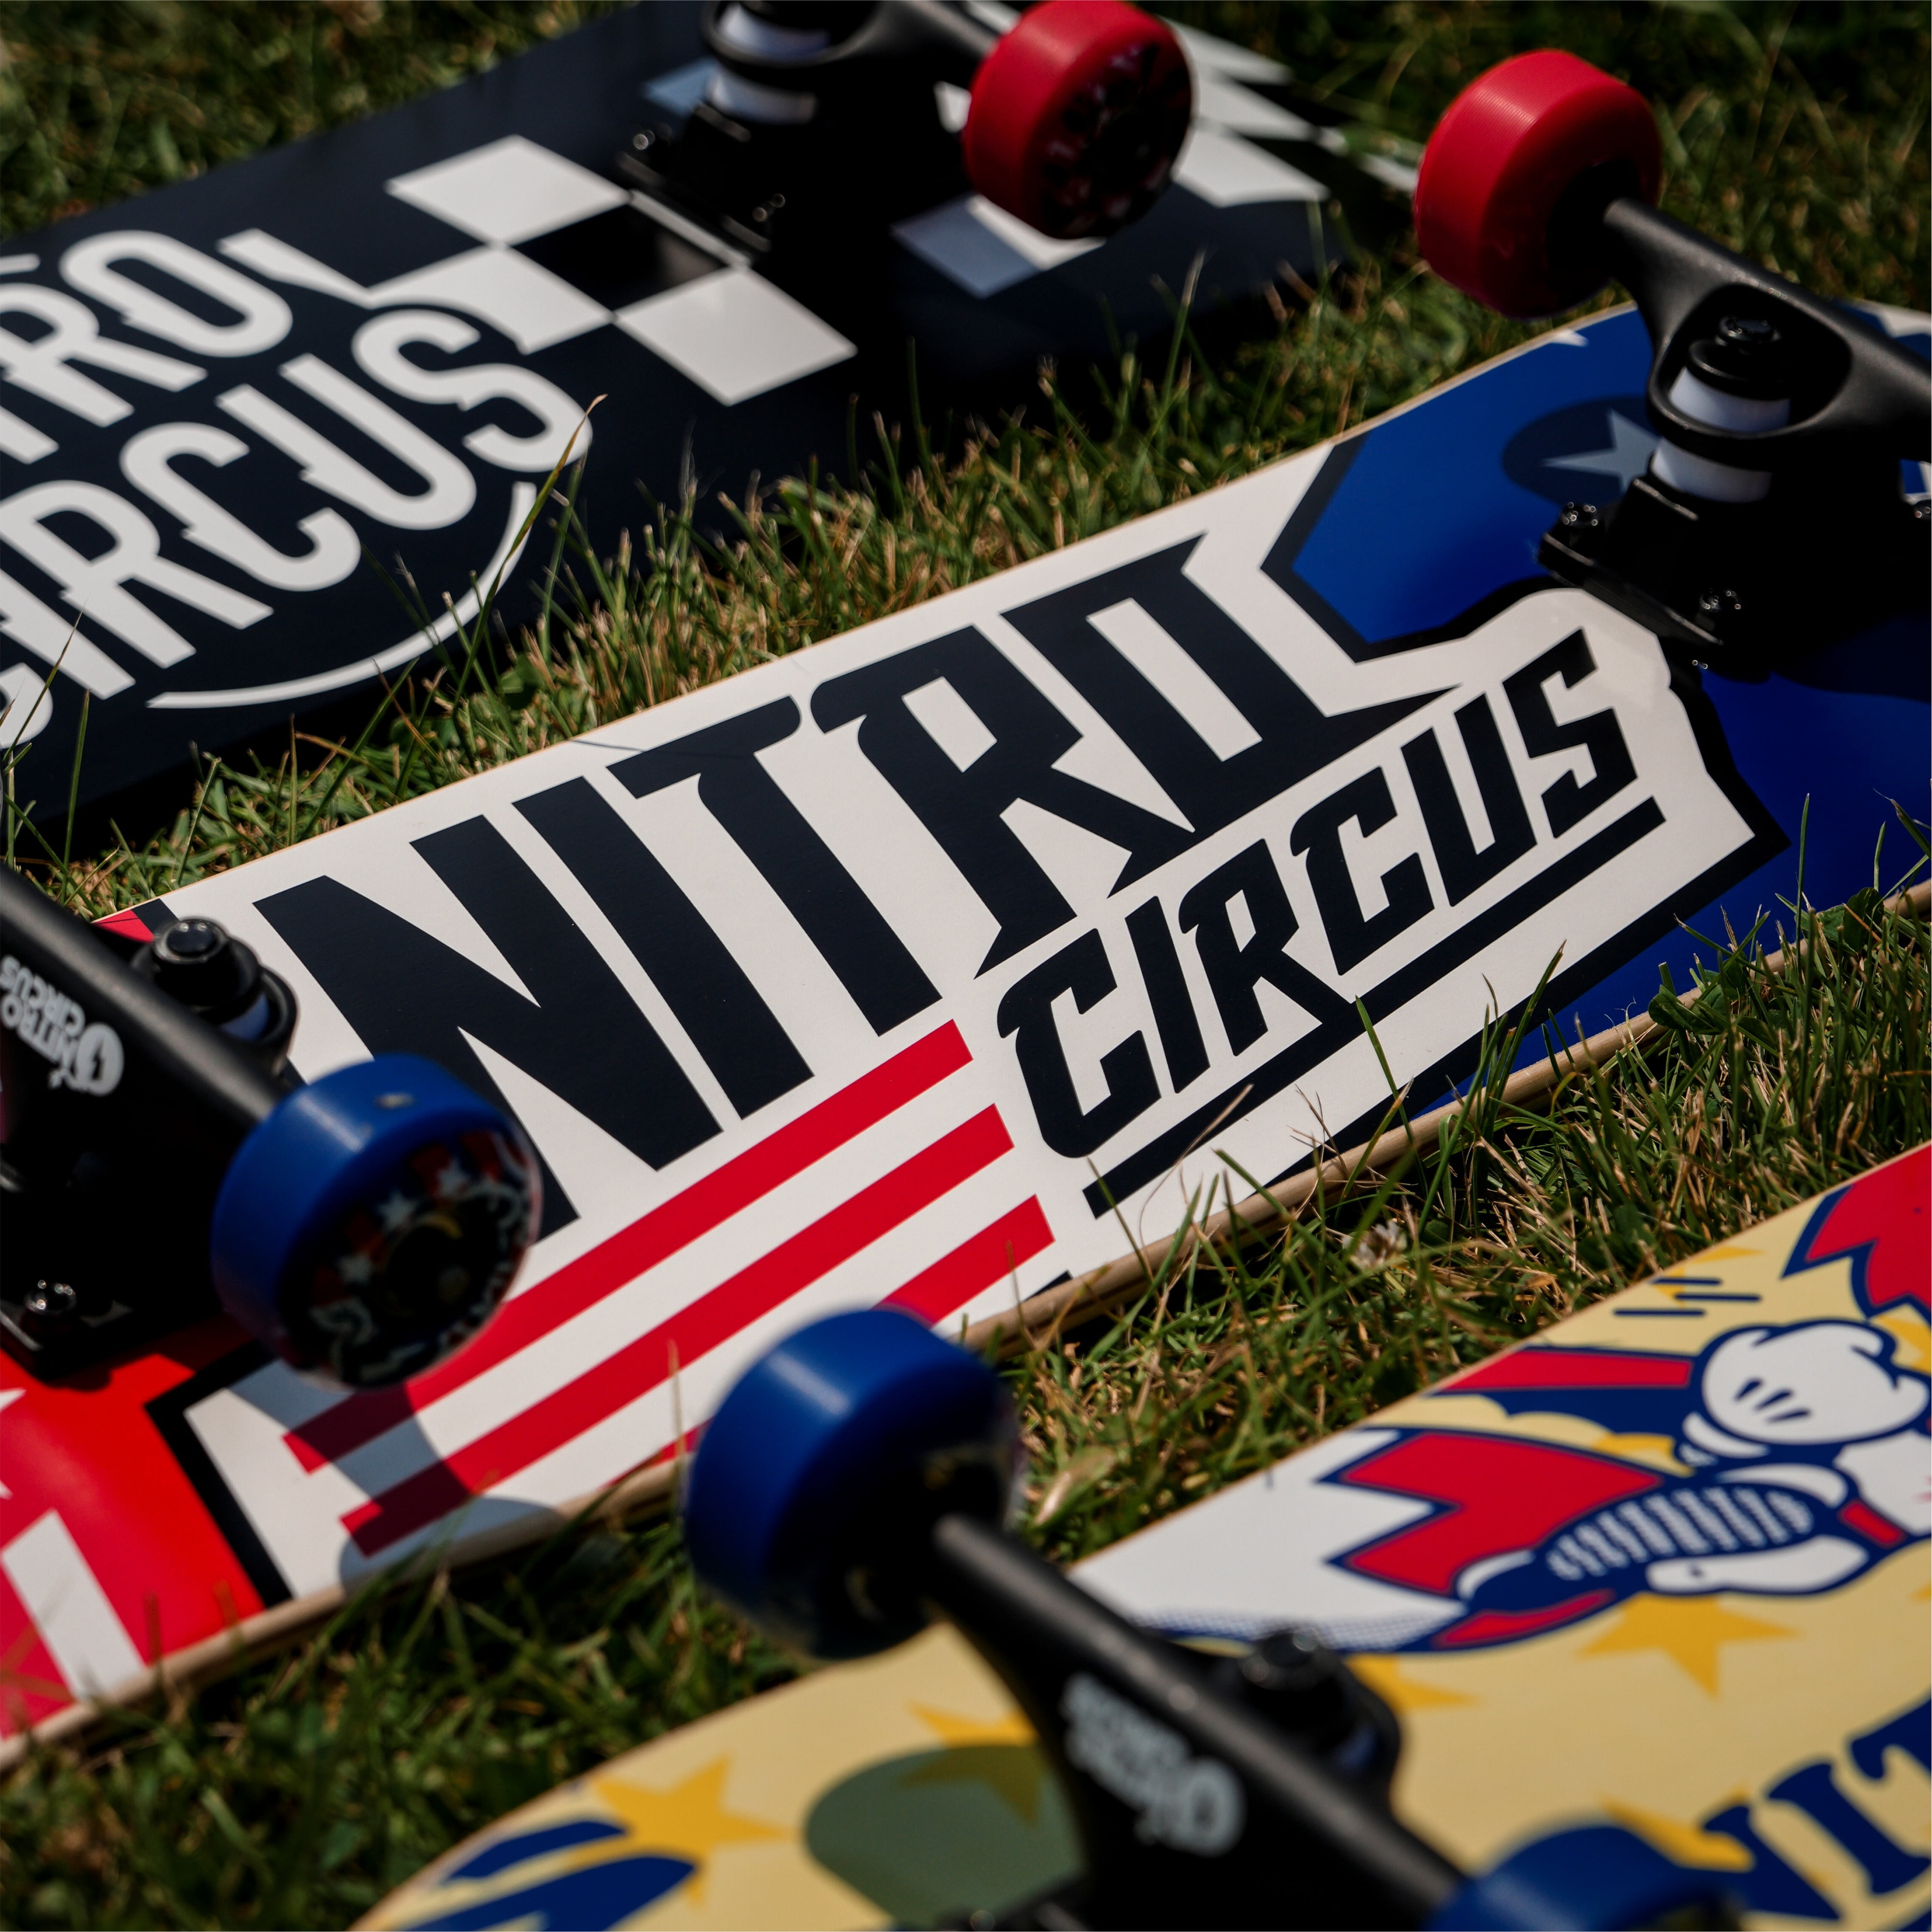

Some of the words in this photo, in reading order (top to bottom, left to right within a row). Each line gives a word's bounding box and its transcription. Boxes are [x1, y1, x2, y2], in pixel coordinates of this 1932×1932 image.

[0, 954, 86, 1037] CIRCUS
[1, 993, 80, 1070] NITRO
[252, 530, 1463, 1245] NITRO
[996, 627, 1638, 1159] CIRCUS
